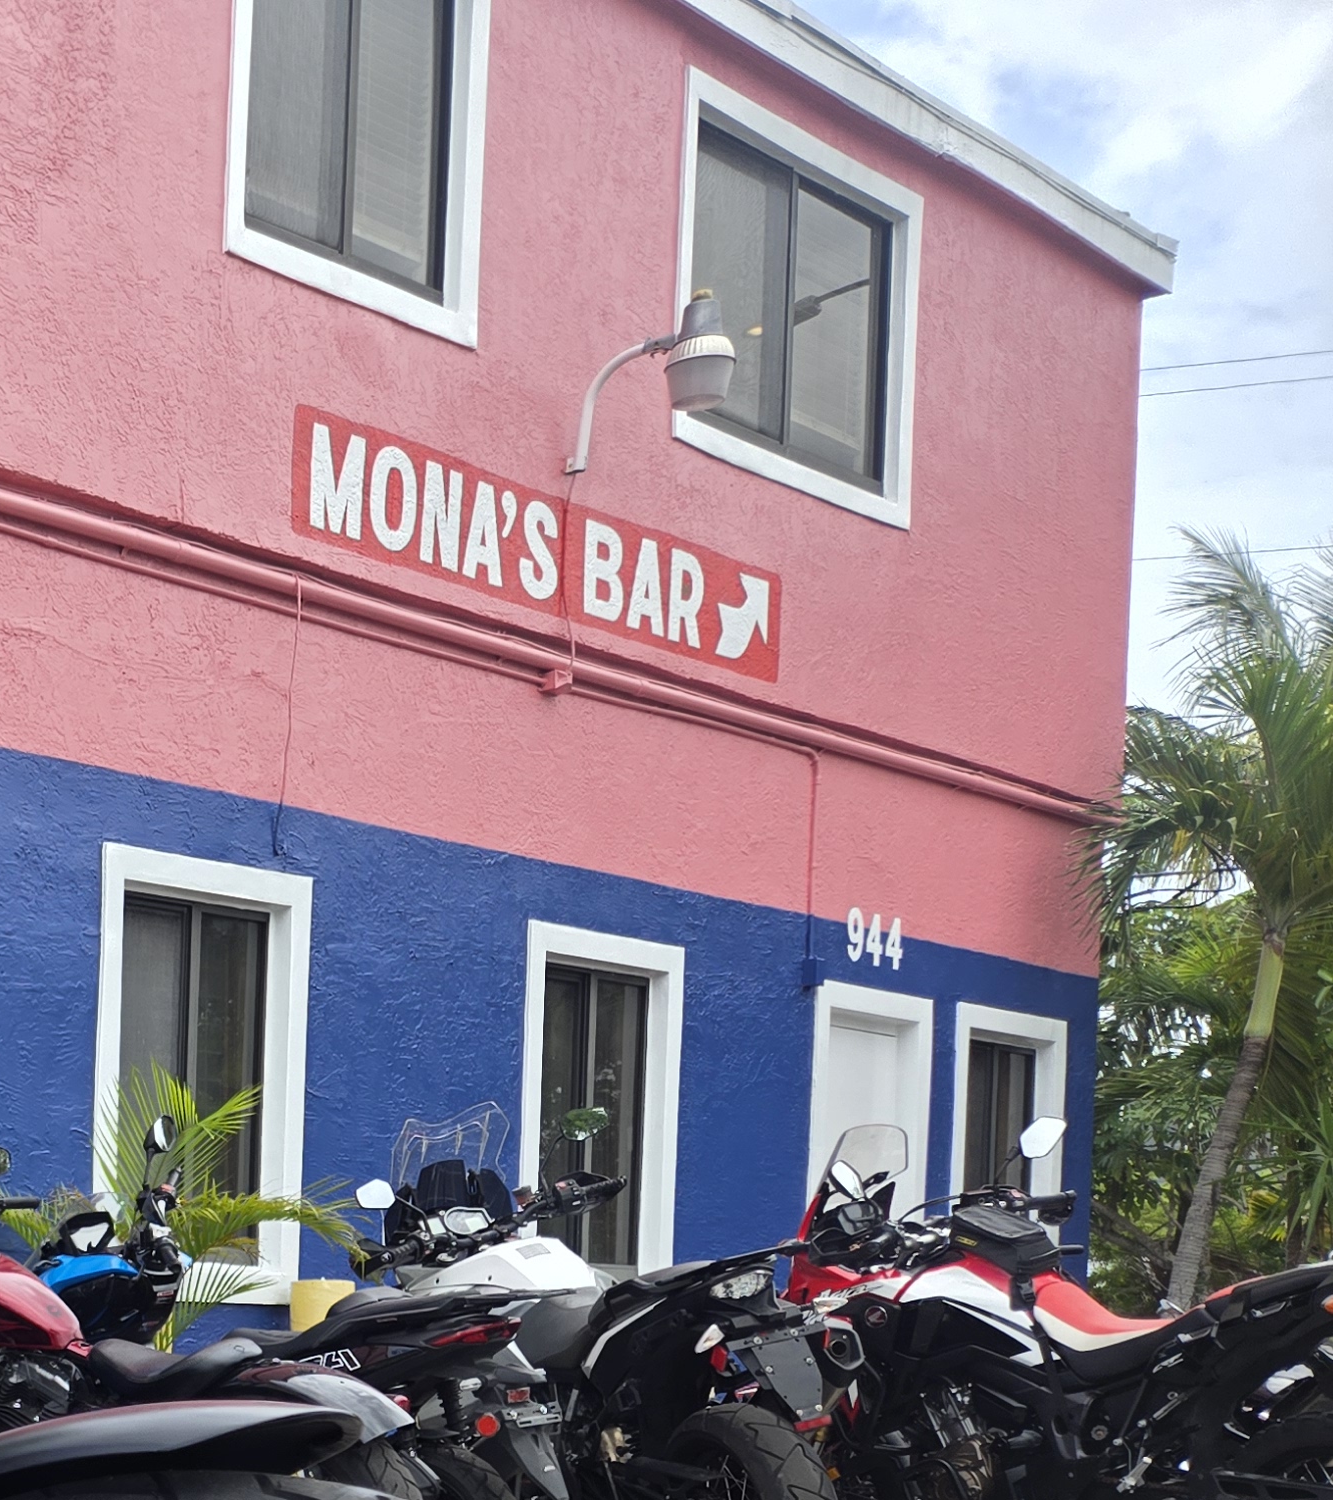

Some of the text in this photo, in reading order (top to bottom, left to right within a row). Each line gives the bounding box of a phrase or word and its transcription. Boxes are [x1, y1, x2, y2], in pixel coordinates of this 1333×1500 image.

[309, 422, 705, 649] MONA'S BAR
[847, 907, 903, 970] 944
